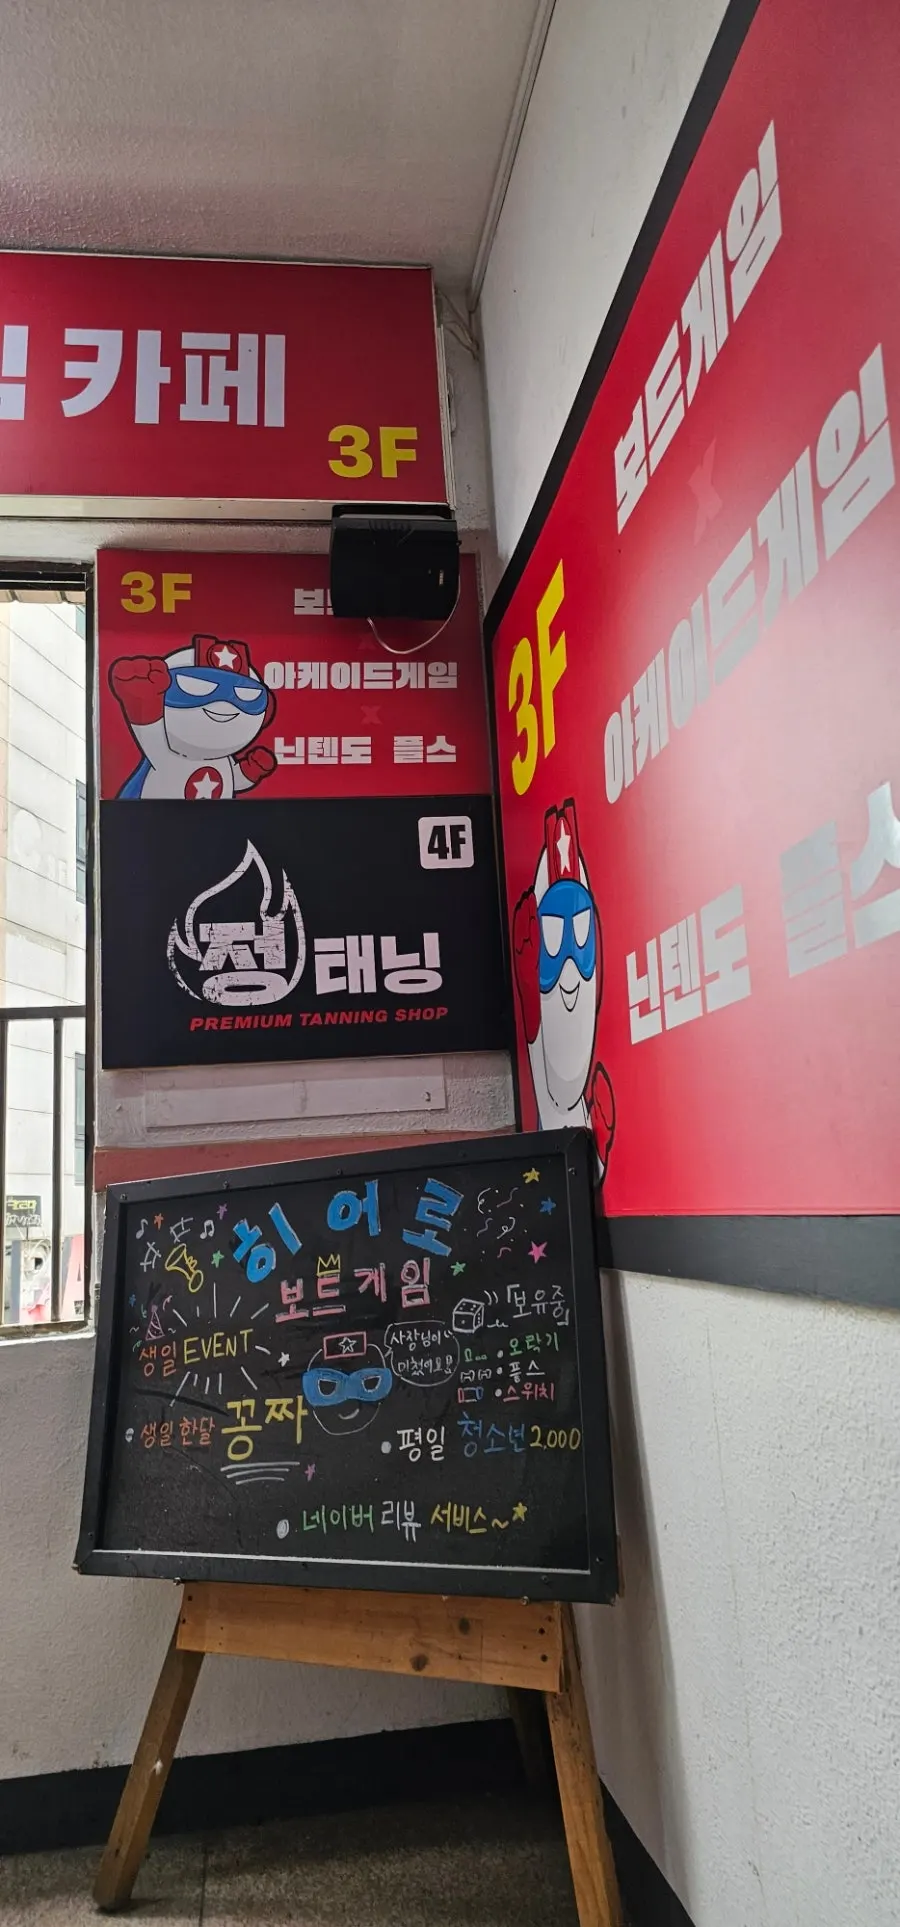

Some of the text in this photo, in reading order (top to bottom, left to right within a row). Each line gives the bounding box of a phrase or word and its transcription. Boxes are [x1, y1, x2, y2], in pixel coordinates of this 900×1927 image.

[614, 119, 783, 535] 보드게임
[61, 327, 286, 427] 카페
[328, 424, 418, 479] 3F
[120, 570, 193, 614] 3F
[604, 343, 895, 804] 아케이드게임
[263, 661, 458, 690] 아케이드게임
[508, 558, 568, 796] 3F
[273, 735, 457, 765] 닌텐도 플스
[427, 824, 467, 860] 4F
[626, 883, 752, 1045] 닌텐도
[189, 1006, 448, 1031] PREMIUM TANNING SHOP
[139, 1328, 254, 1377] 생일 EVENT
[509, 1331, 559, 1357] 오락기
[503, 1382, 555, 1403] 스위치
[140, 1421, 173, 1449] 생일
[221, 1394, 308, 1461] 꽁짜
[397, 1411, 582, 1462] 평일 청소년 2,000
[302, 1504, 374, 1535] 네이버
[381, 1500, 422, 1543] 리뷰
